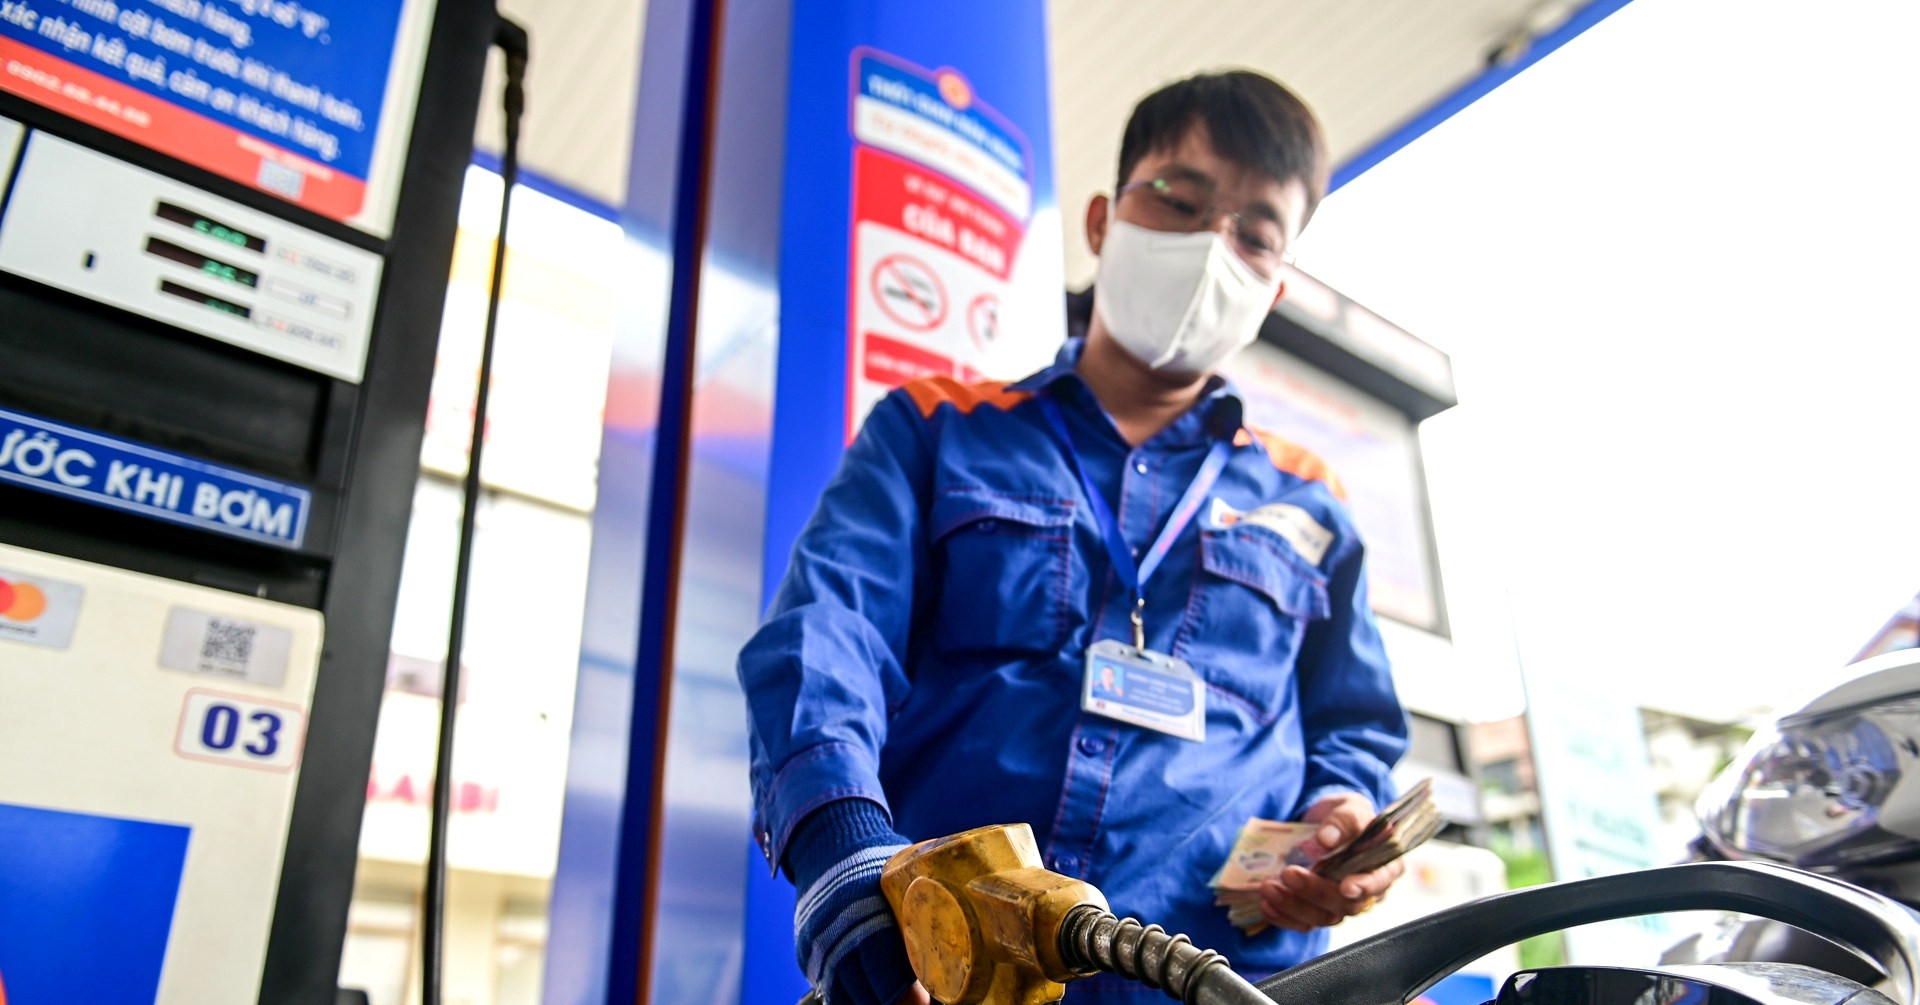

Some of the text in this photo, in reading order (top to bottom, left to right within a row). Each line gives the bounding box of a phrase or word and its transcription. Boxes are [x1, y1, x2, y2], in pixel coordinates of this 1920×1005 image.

[38, 16, 92, 53] nhận
[104, 459, 184, 511] KHI
[192, 481, 293, 538] BƠM
[201, 704, 283, 757] 03
